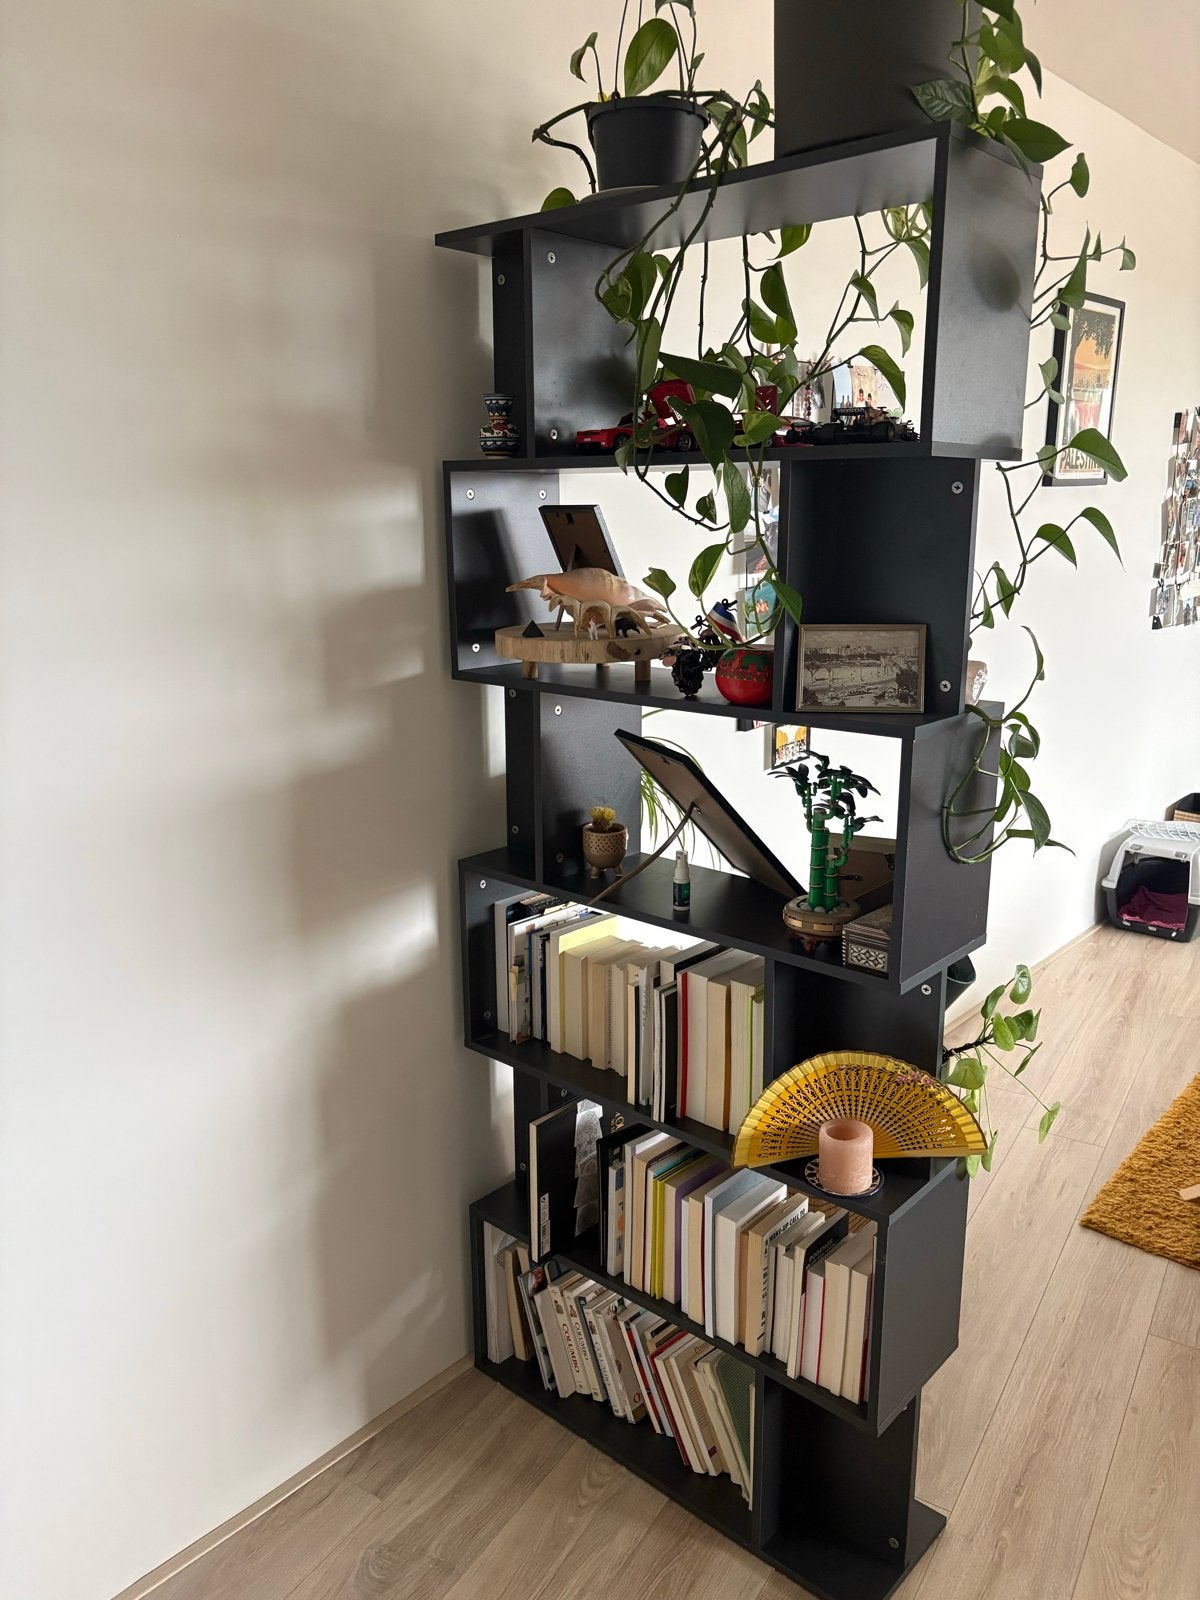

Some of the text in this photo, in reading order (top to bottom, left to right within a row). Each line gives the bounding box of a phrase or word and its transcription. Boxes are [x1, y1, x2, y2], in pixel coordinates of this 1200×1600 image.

[1060, 448, 1102, 469] PALESTI
[789, 1213, 800, 1226] CALL
[562, 1322, 581, 1374] COLUMBO
[574, 1321, 589, 1361] COLUMBO
